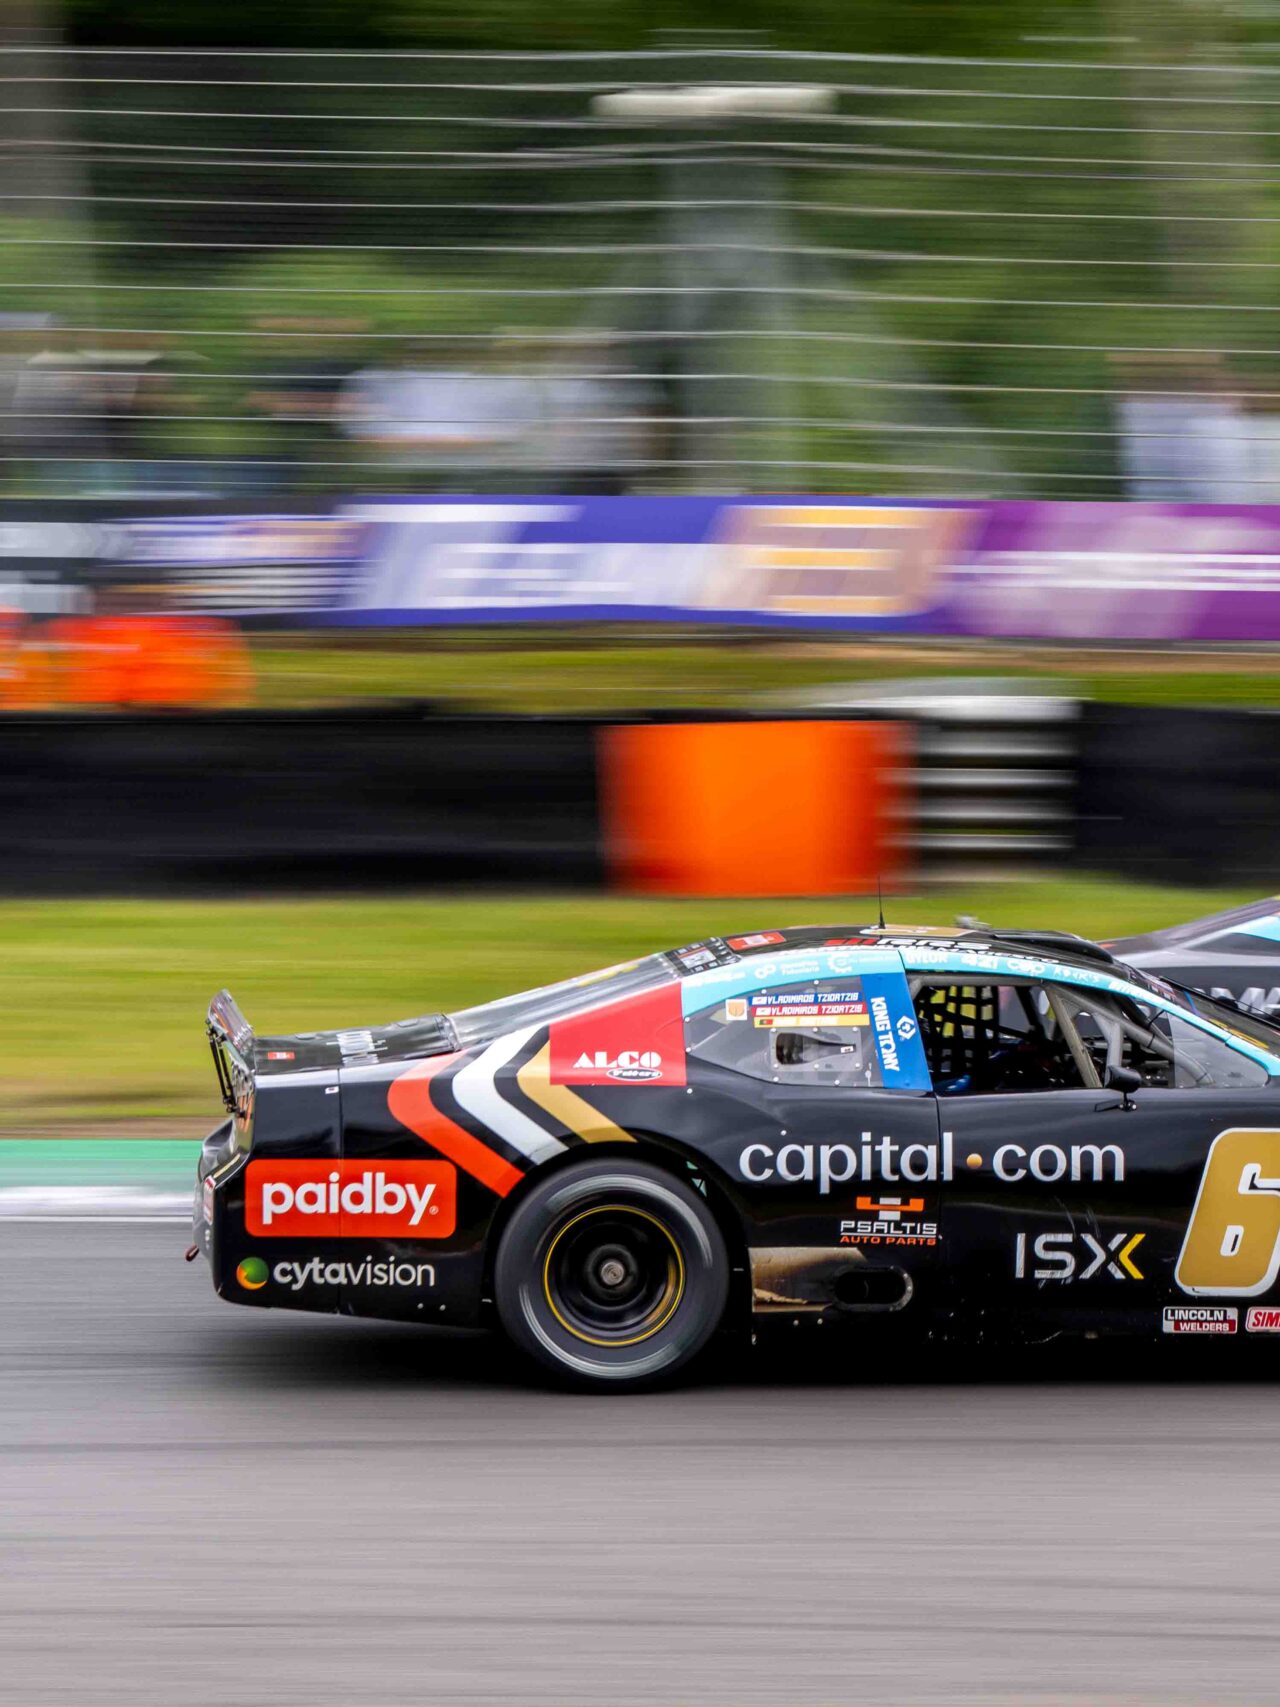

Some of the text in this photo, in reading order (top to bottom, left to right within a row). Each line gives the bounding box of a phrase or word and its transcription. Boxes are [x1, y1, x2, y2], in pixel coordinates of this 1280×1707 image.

[870, 996, 901, 1072] KING TONY
[573, 1051, 662, 1069] ALCO
[262, 1172, 437, 1226] paidby
[840, 1220, 938, 1235] PSALTIS
[840, 1235, 937, 1247] AUTO PARTS
[273, 1255, 436, 1291] cytavision
[1167, 1309, 1225, 1321] LINCOLN
[1179, 1321, 1230, 1331] WELDERS
